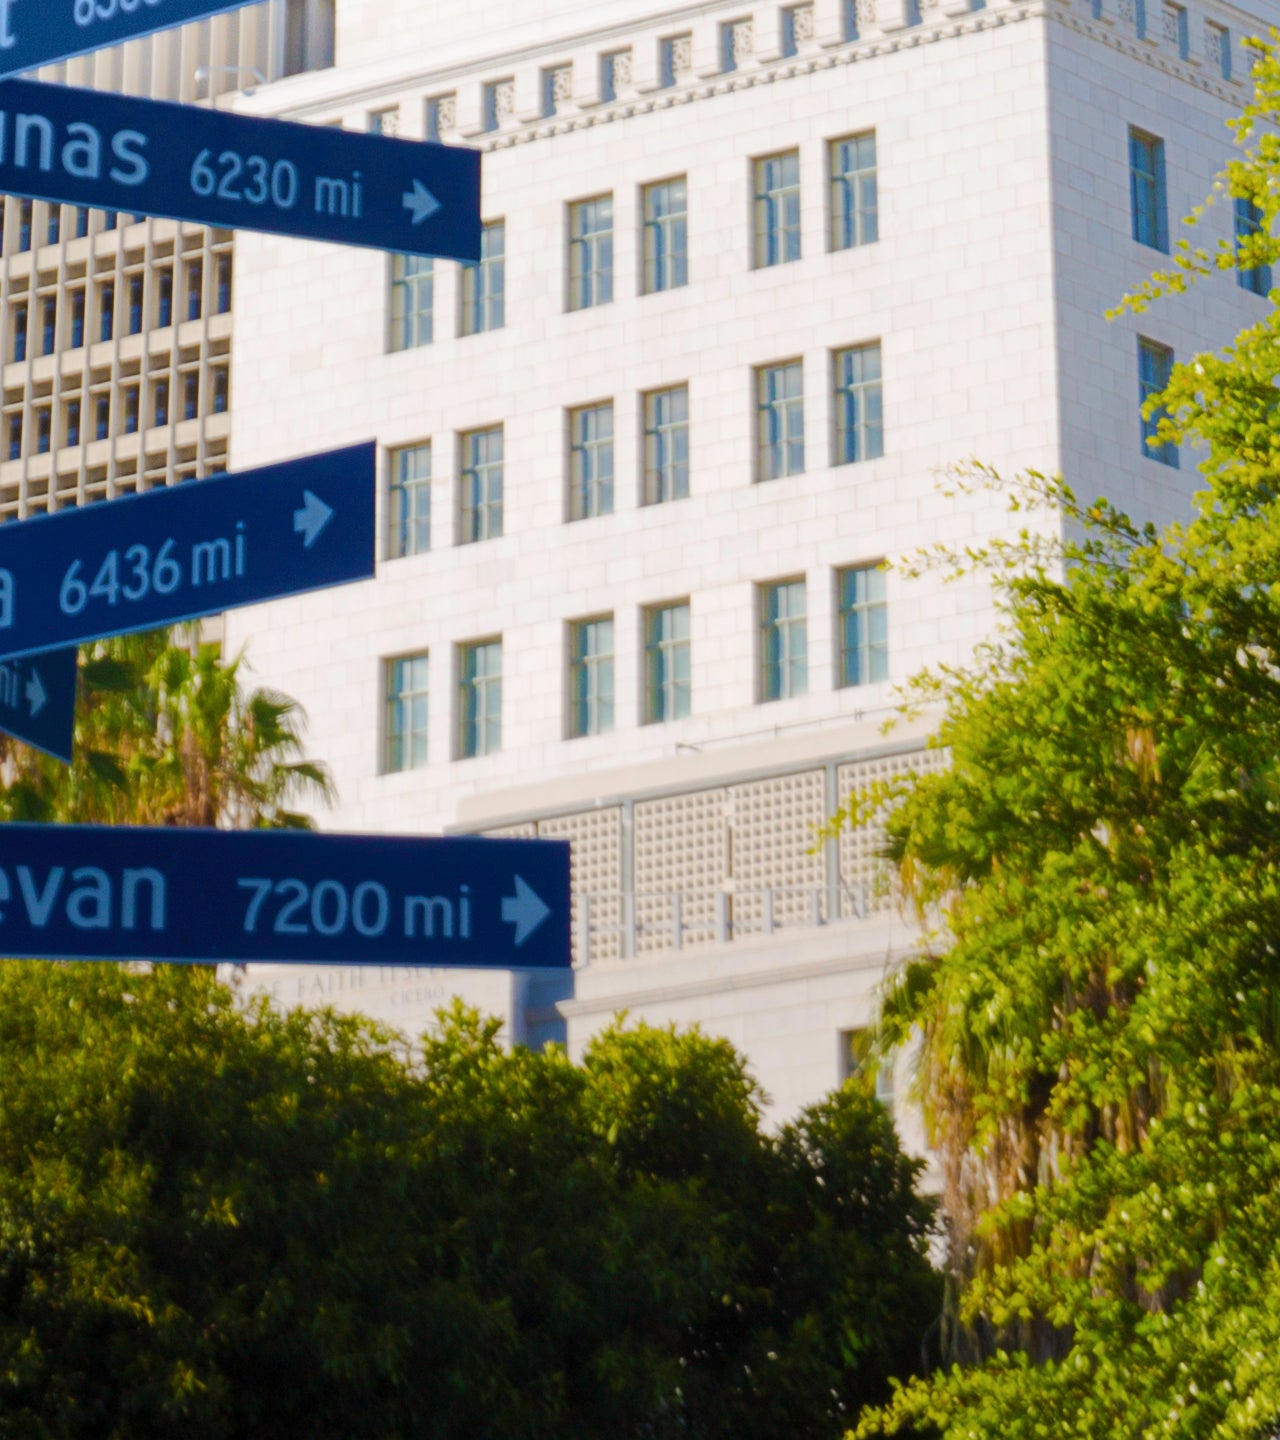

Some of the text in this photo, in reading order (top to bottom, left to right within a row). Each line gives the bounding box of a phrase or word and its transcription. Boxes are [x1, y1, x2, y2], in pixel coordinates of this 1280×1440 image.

[189, 149, 297, 210] 6230
[315, 163, 363, 217] mi
[59, 538, 181, 615] 6436
[190, 522, 245, 584] mi
[236, 878, 390, 937] 7200
[404, 884, 471, 939] mi
[298, 967, 363, 998] FAITH
